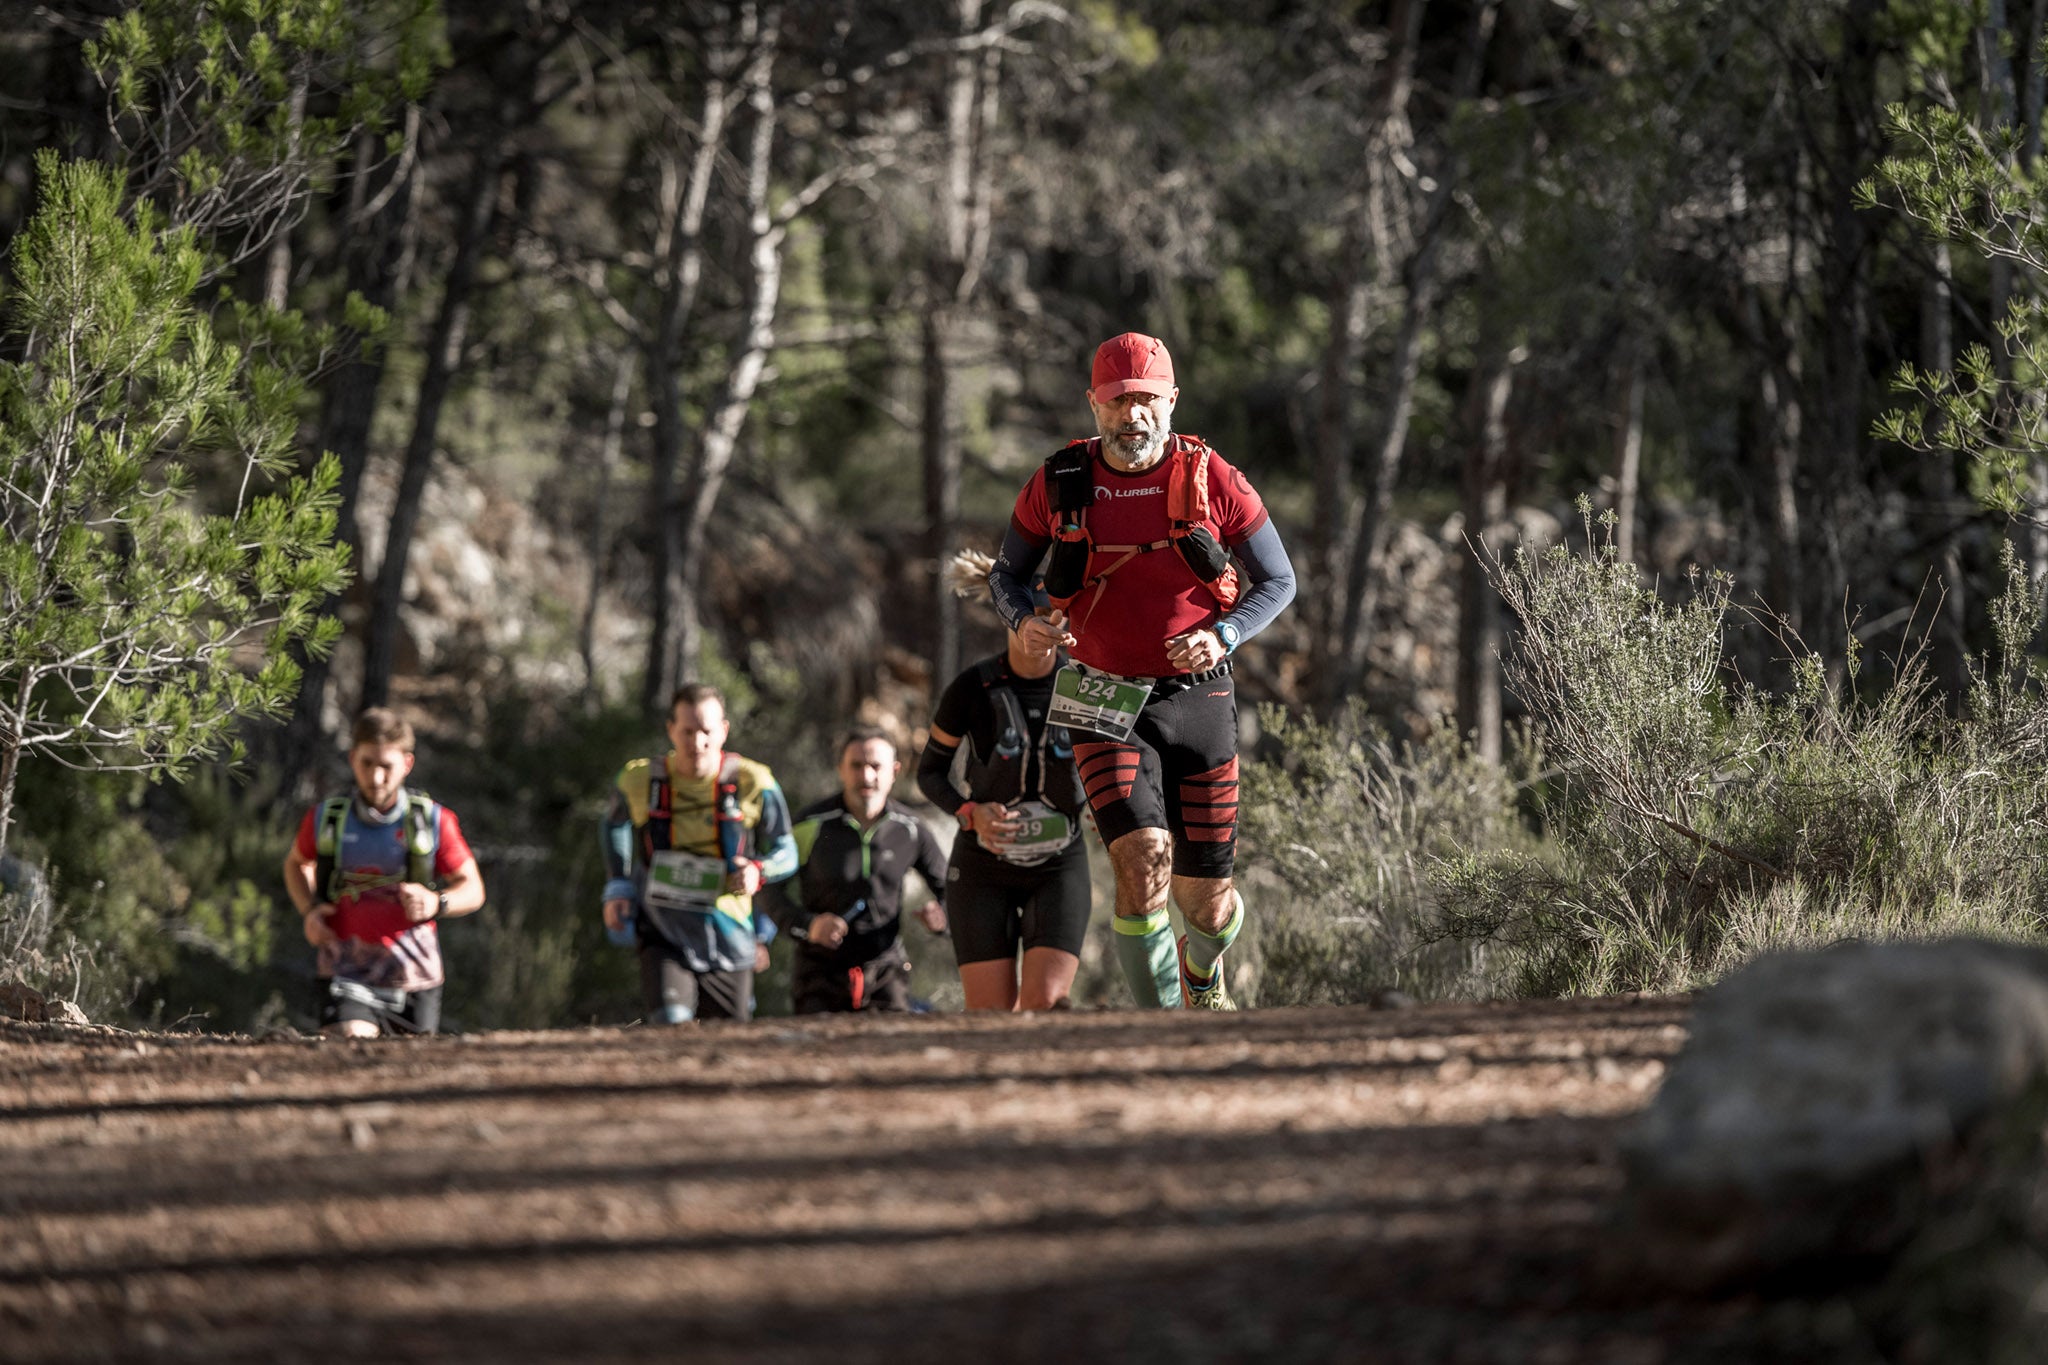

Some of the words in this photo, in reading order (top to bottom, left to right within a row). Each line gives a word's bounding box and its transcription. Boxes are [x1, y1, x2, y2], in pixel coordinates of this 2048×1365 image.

[1115, 486, 1164, 497] LURBEL
[1078, 677, 1118, 701] 624
[1005, 820, 1043, 837] 39
